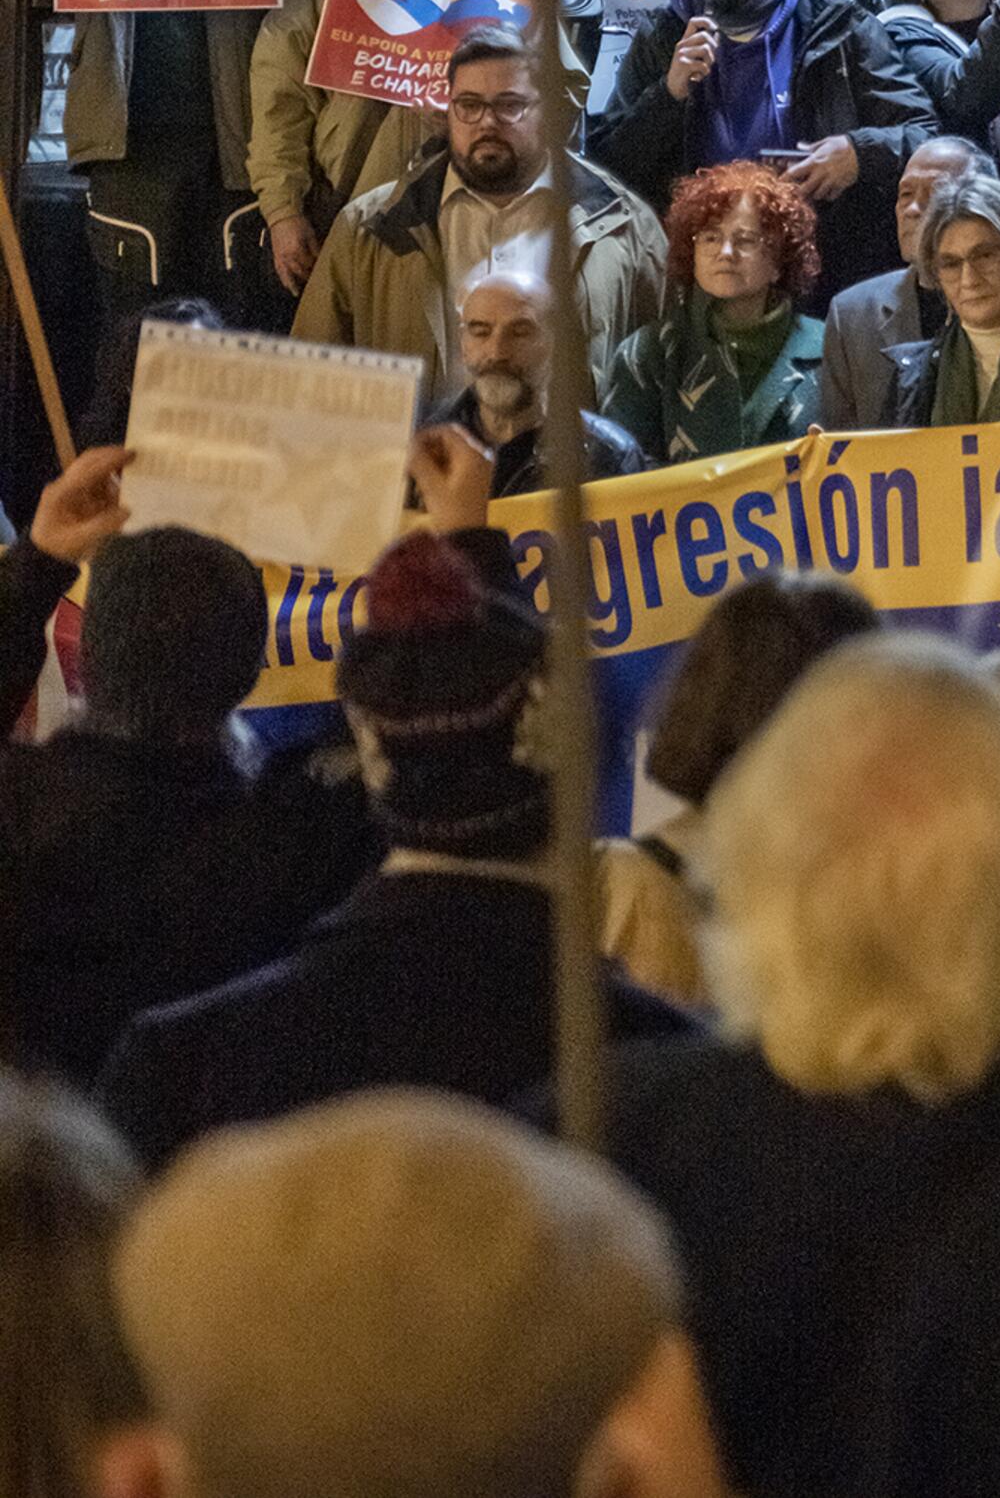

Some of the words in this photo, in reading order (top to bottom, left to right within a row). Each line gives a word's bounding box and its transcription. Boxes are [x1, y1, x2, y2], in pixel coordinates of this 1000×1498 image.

[330, 29, 353, 42] EU
[356, 34, 407, 56] APOIO
[410, 48, 422, 60] A
[426, 50, 453, 61] VEN
[354, 50, 450, 79] BOLIVARI
[351, 69, 366, 86] E
[370, 74, 450, 98] CHAVIST
[262, 564, 370, 668] lt
[513, 440, 921, 649] agresión
